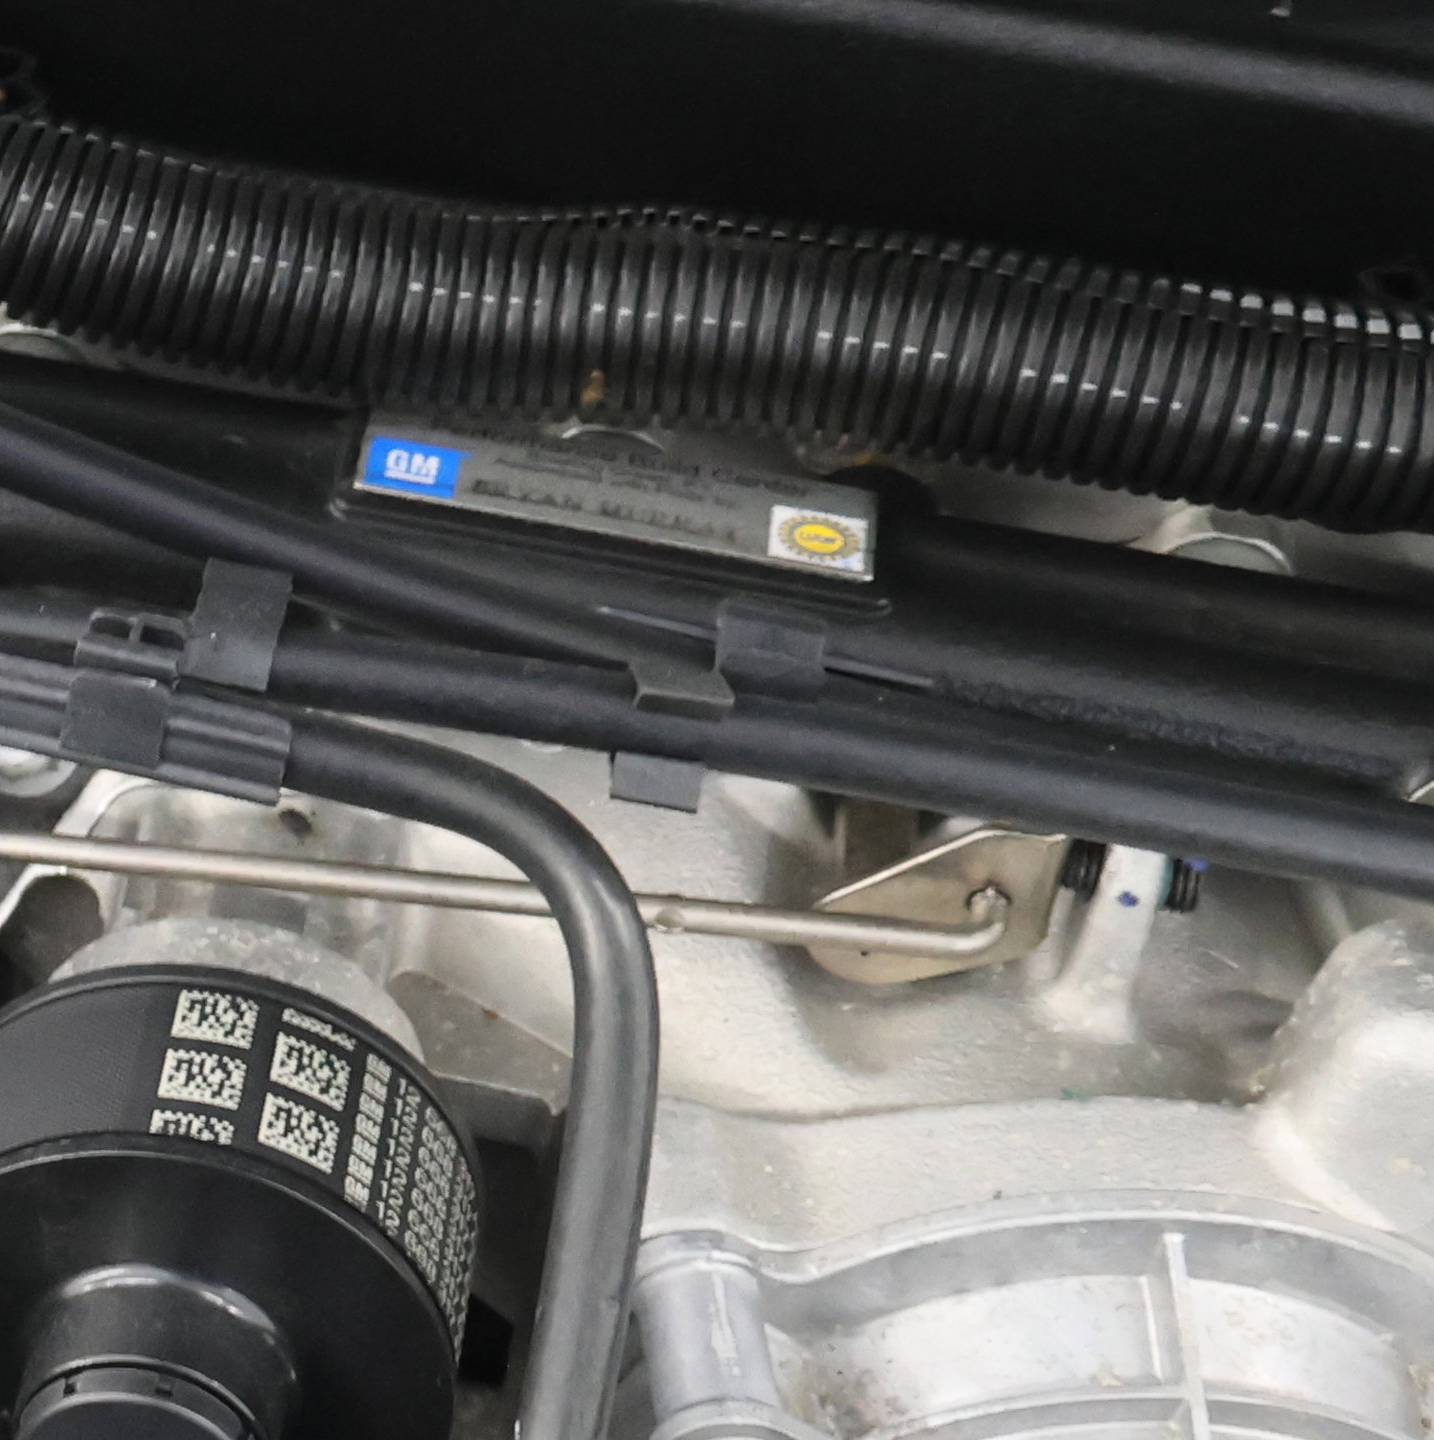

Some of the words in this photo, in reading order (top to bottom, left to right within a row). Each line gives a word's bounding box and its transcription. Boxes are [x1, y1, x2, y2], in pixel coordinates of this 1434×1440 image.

[383, 447, 441, 485] GM
[400, 1078, 421, 1109] 12
[395, 1097, 418, 1130] 12
[391, 1117, 414, 1152] 12
[387, 1137, 411, 1171] 12
[384, 1158, 407, 1192] 12
[380, 1179, 403, 1212] 12
[376, 1200, 400, 1233] 12
